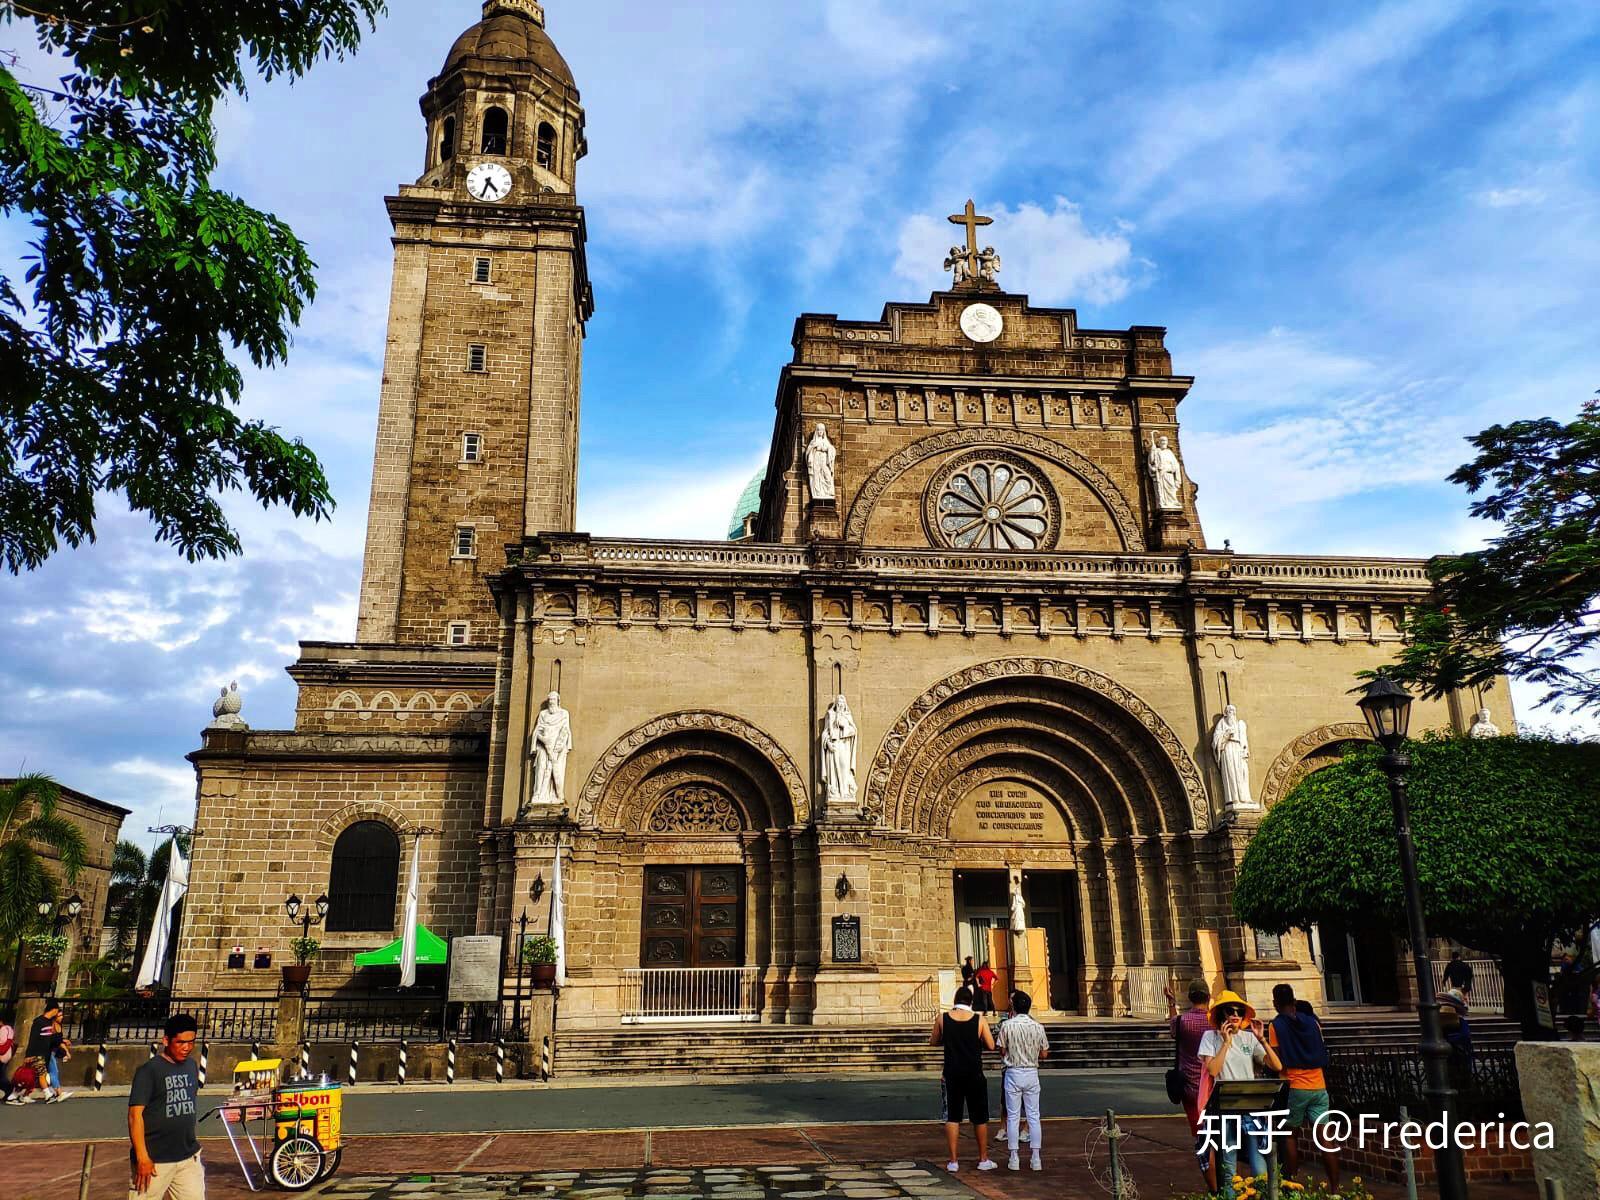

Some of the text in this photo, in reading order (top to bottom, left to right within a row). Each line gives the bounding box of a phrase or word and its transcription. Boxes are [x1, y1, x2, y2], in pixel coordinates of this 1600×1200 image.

[165, 1074, 192, 1090] BEST.
[166, 1088, 191, 1104] BRO.
[166, 1101, 195, 1118] EVER
